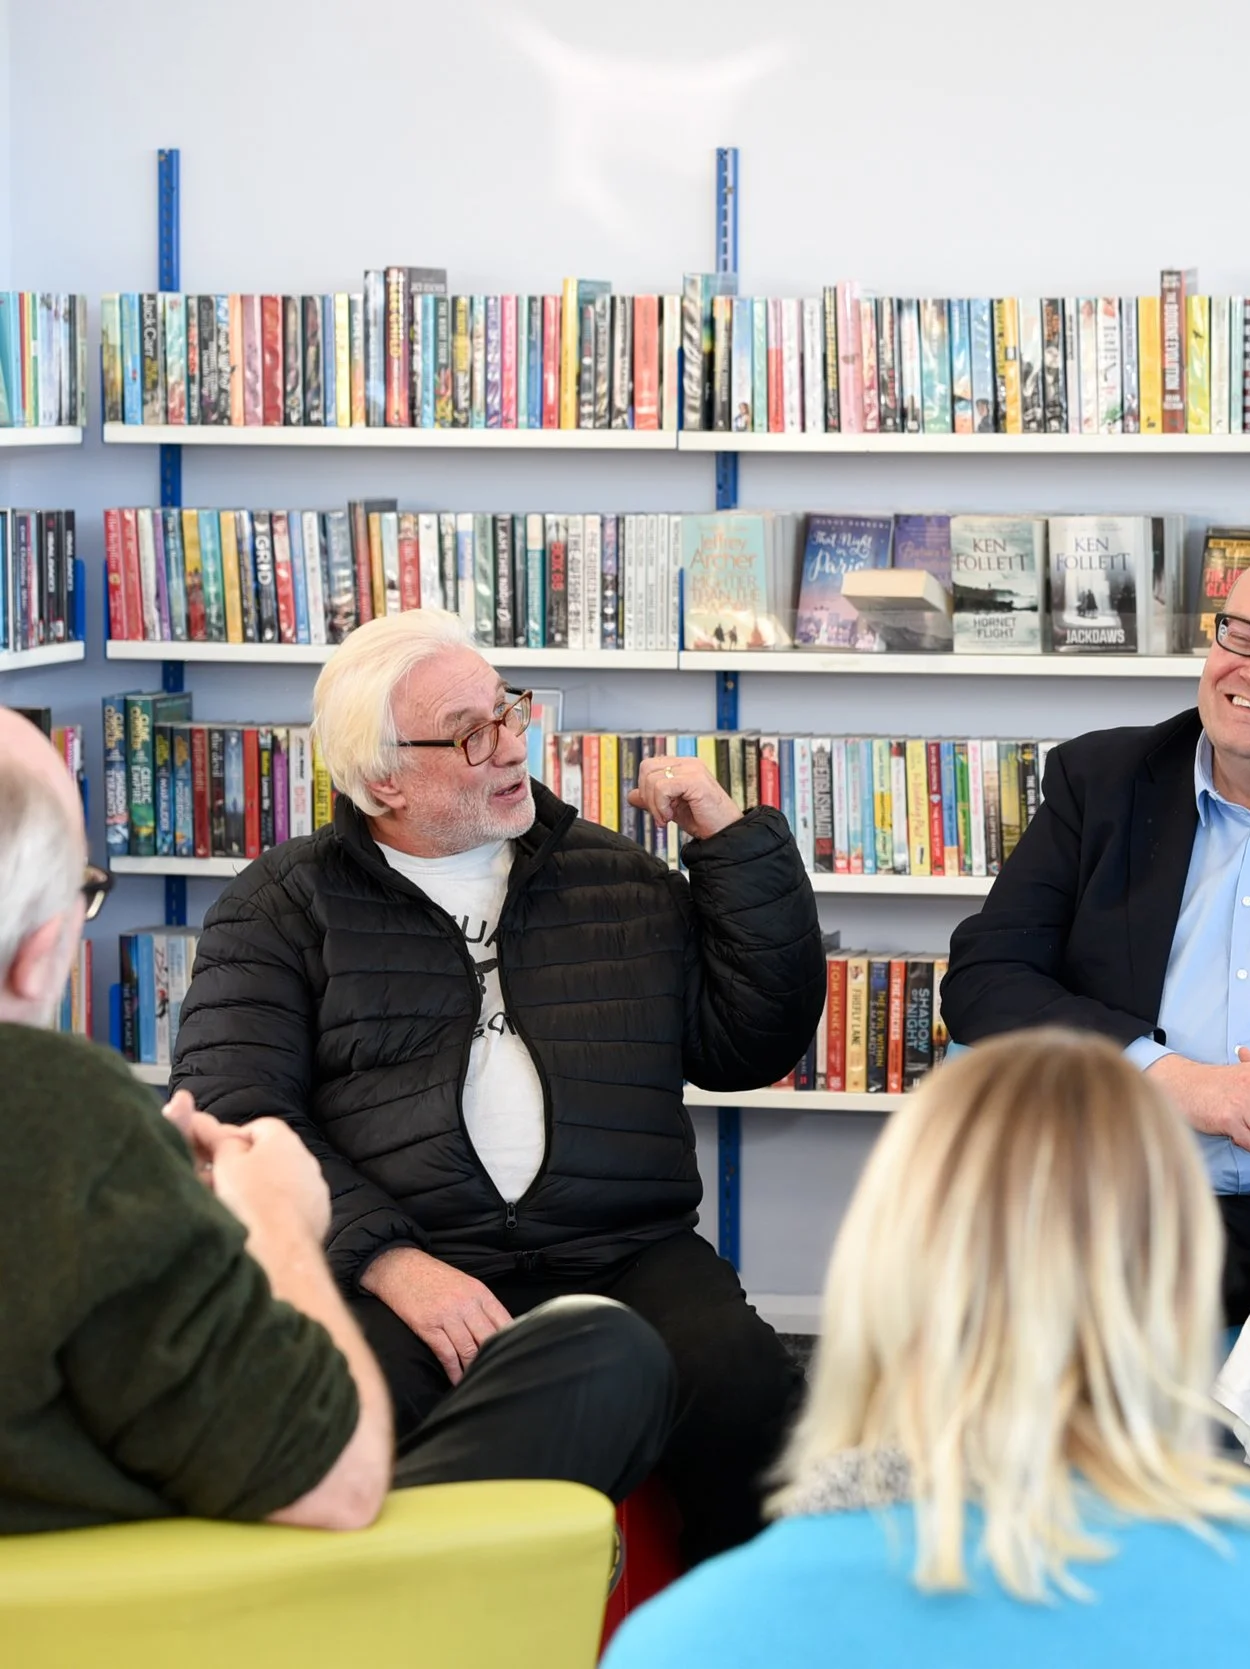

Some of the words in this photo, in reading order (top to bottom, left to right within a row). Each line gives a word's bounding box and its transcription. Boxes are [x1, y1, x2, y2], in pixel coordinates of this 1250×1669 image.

[143, 294, 157, 328] Jack
[144, 328, 158, 358] Carr
[702, 533, 748, 550] Jeffrey
[812, 530, 837, 548] That
[839, 532, 873, 556] Night
[972, 538, 1007, 553] KEN
[1075, 537, 1109, 552] KEN
[690, 550, 757, 571] Archer
[955, 553, 1028, 571] FOLLETT
[1056, 553, 1131, 571] FOLLETT
[974, 617, 1016, 629] HORNET
[977, 628, 1015, 639] FLIGHT
[1065, 629, 1125, 644] JACKDAWS
[131, 765, 142, 805] EMPIRE
[140, 766, 152, 804] CELTIC
[1026, 775, 1035, 788] THE
[1026, 789, 1035, 805] GIRL
[831, 964, 841, 992] TOM
[892, 977, 901, 996] THE
[851, 988, 863, 1022] FIREFLY
[876, 990, 886, 1008] THE
[831, 996, 841, 1037] HANKS
[876, 1010, 886, 1030] EVIL
[891, 999, 901, 1041] MERCIES
[906, 1003, 918, 1049] NIGHT
[917, 988, 931, 1053] SHADOW
[850, 1024, 862, 1047] LANE
[868, 1021, 876, 1056] HARDY
[875, 1034, 885, 1067] WITHIN
